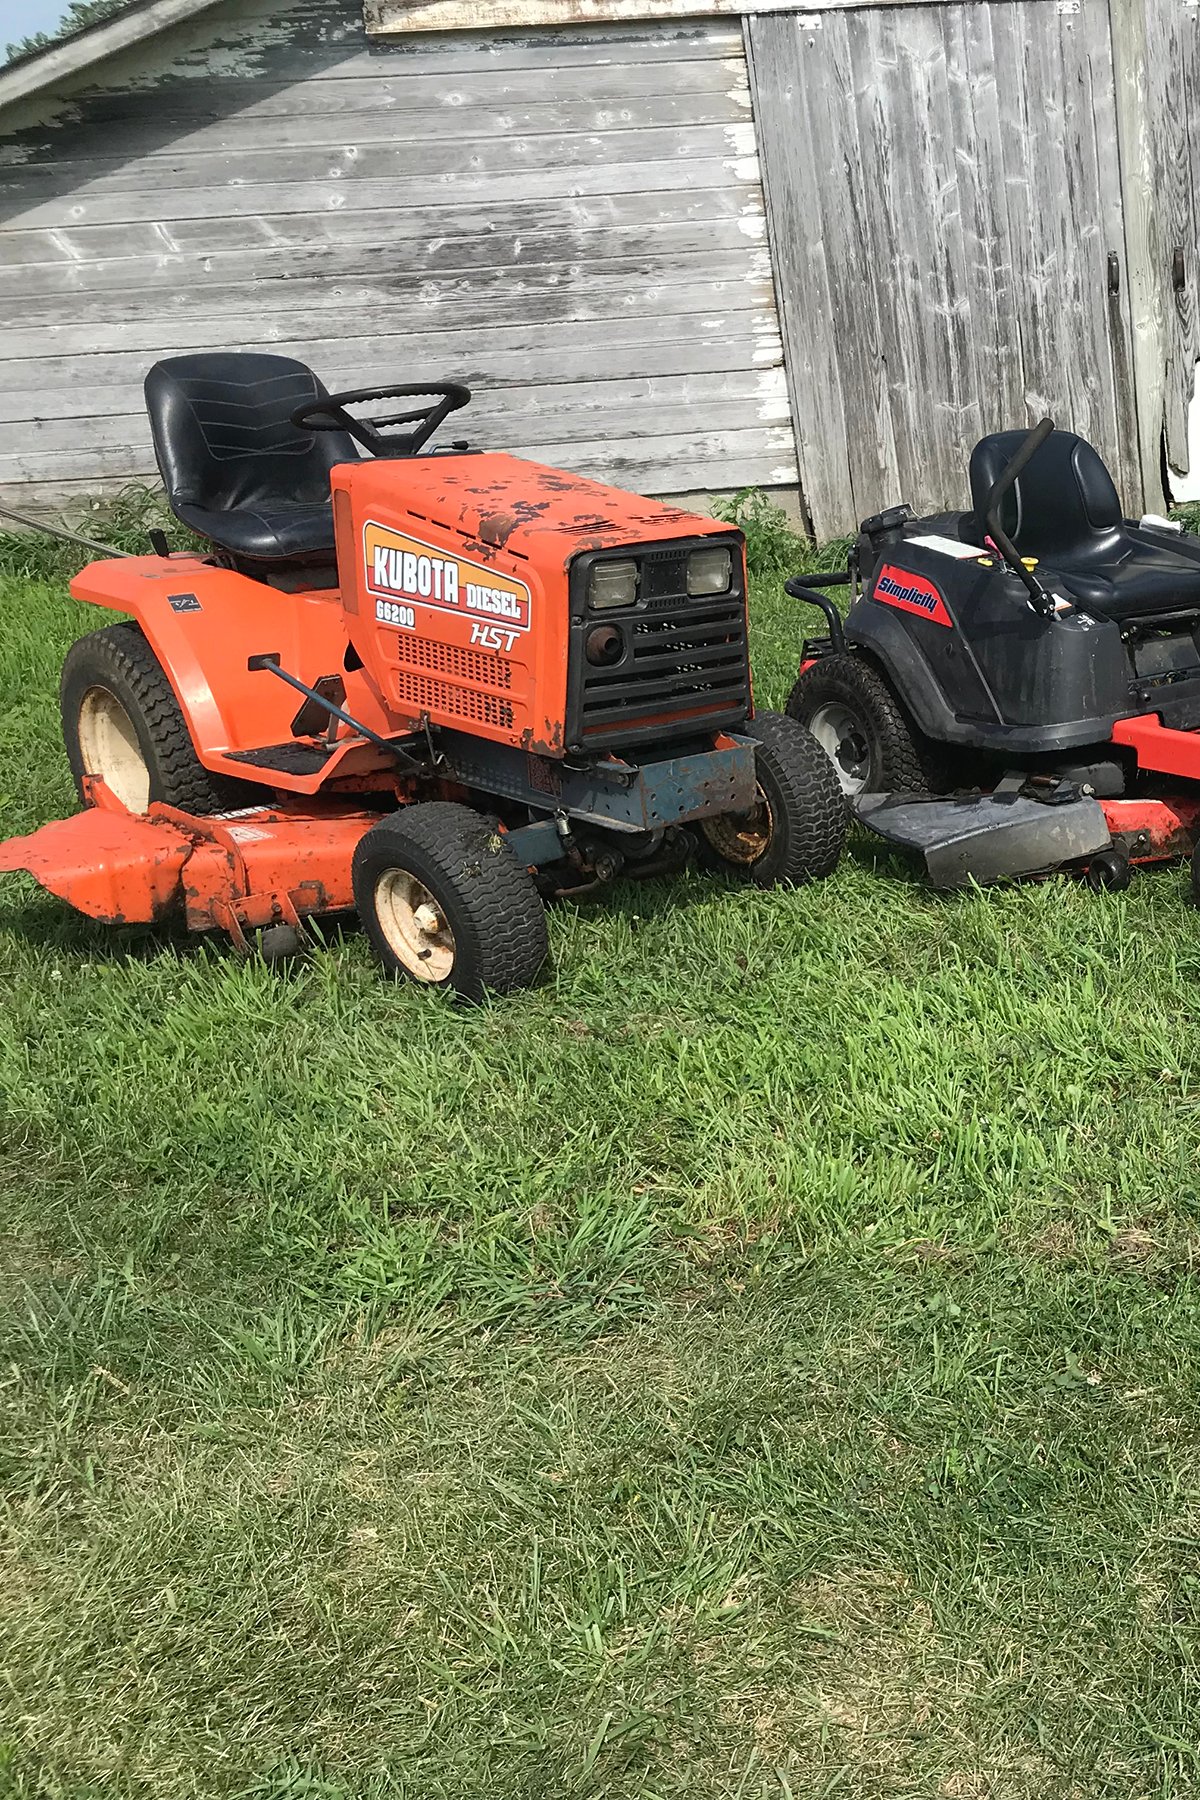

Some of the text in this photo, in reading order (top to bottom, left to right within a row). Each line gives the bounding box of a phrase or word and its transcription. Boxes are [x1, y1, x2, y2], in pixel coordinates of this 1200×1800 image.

[373, 545, 522, 619] KUBOTA DIESEL
[878, 577, 938, 613] Simplicity
[375, 599, 415, 627] G6200
[469, 622, 521, 652] HST
